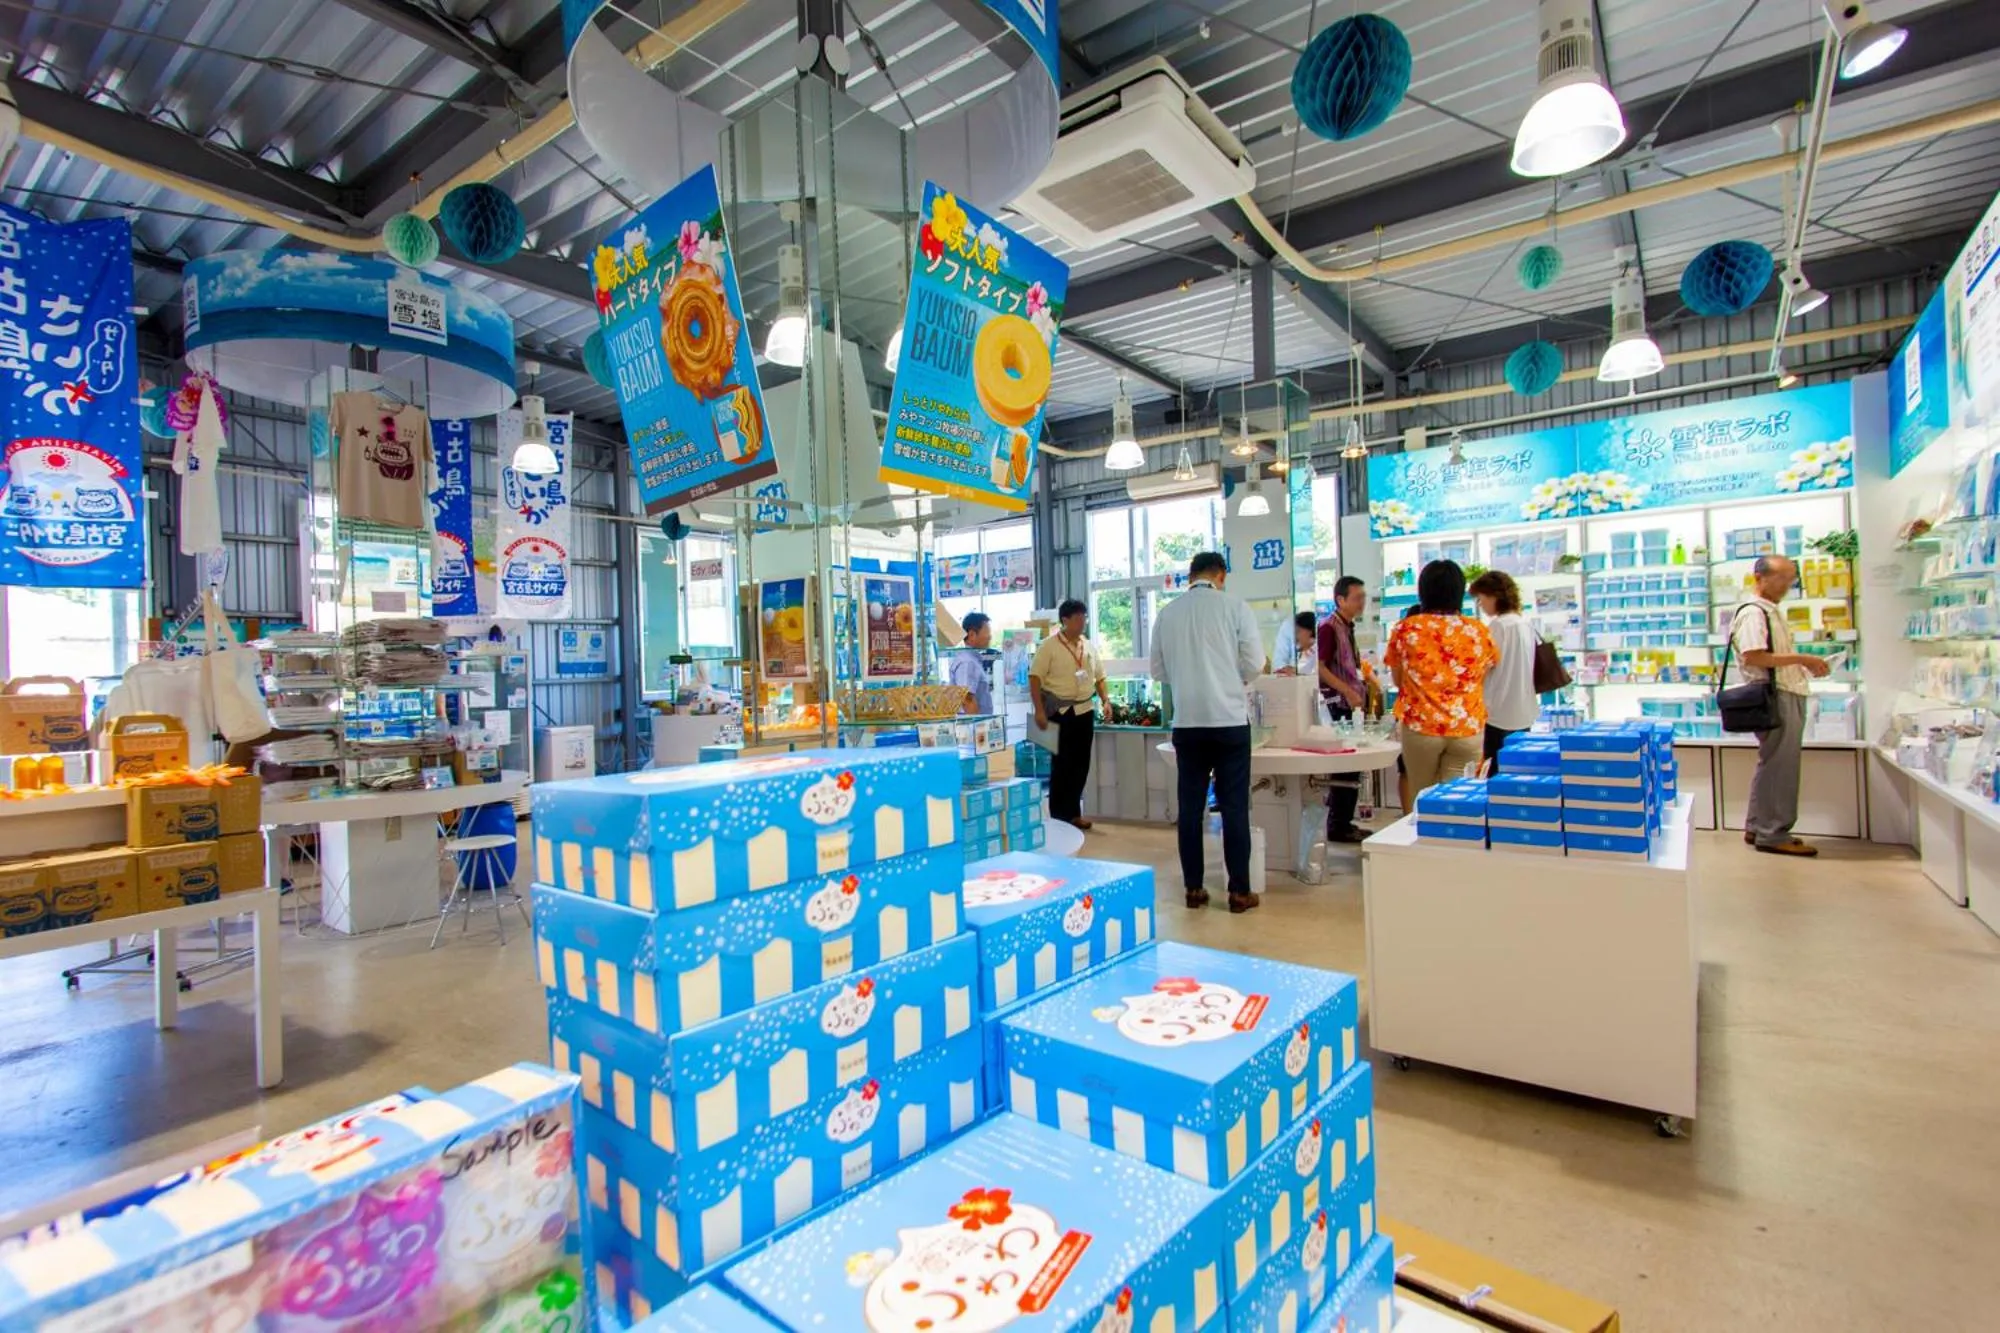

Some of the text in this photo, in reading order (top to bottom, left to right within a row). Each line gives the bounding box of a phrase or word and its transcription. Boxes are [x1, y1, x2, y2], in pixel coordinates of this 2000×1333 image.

[608, 244, 649, 290] 大人気
[950, 227, 999, 275] 大人気
[604, 254, 677, 326] ハードタイプ
[926, 249, 1024, 313] ソフトタイプ
[917, 287, 977, 341] YUKISIO
[617, 348, 664, 402] BAUM
[910, 319, 972, 380] BAUM
[1669, 409, 1791, 452] 雪塩ラボ
[438, 1115, 561, 1181] Sample
